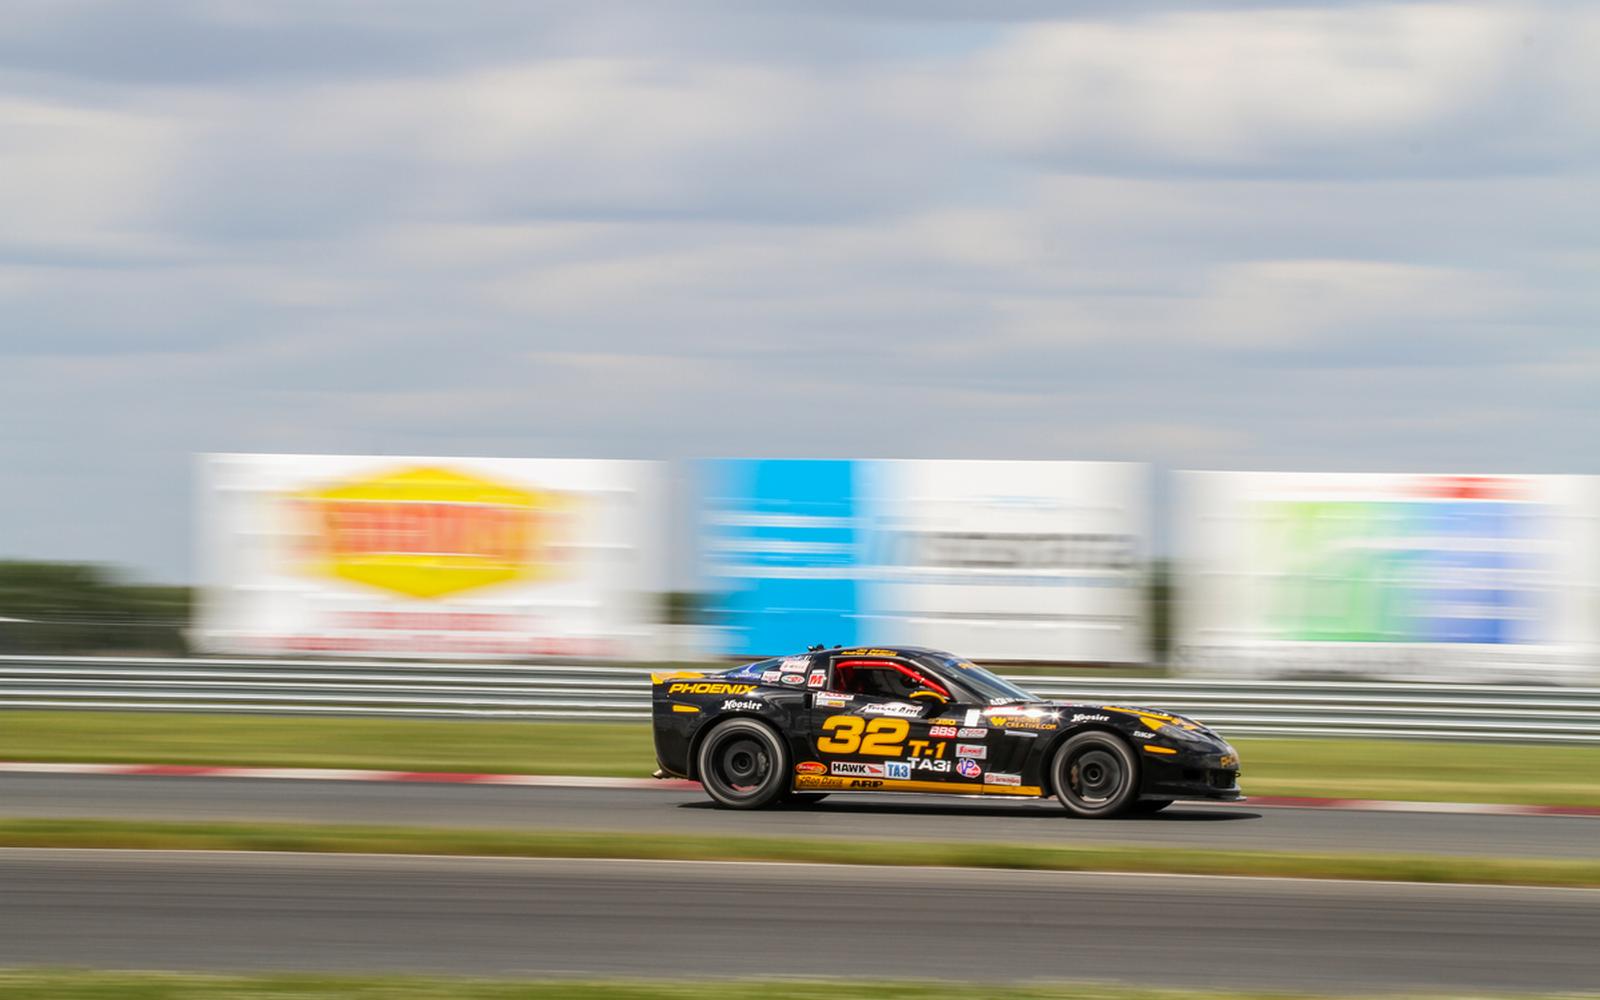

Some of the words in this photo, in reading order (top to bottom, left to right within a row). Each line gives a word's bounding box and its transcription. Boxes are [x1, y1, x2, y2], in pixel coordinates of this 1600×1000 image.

[669, 683, 757, 695] PHOENIX
[721, 700, 762, 711] Hoosier
[1071, 714, 1110, 722] Hoosier
[817, 715, 910, 756] 32
[930, 726, 957, 735] BBS
[907, 740, 946, 758] T-1
[833, 763, 866, 773] HAWK
[907, 757, 952, 772] TA3i
[887, 764, 908, 778] TA3
[850, 780, 883, 788] ARP
